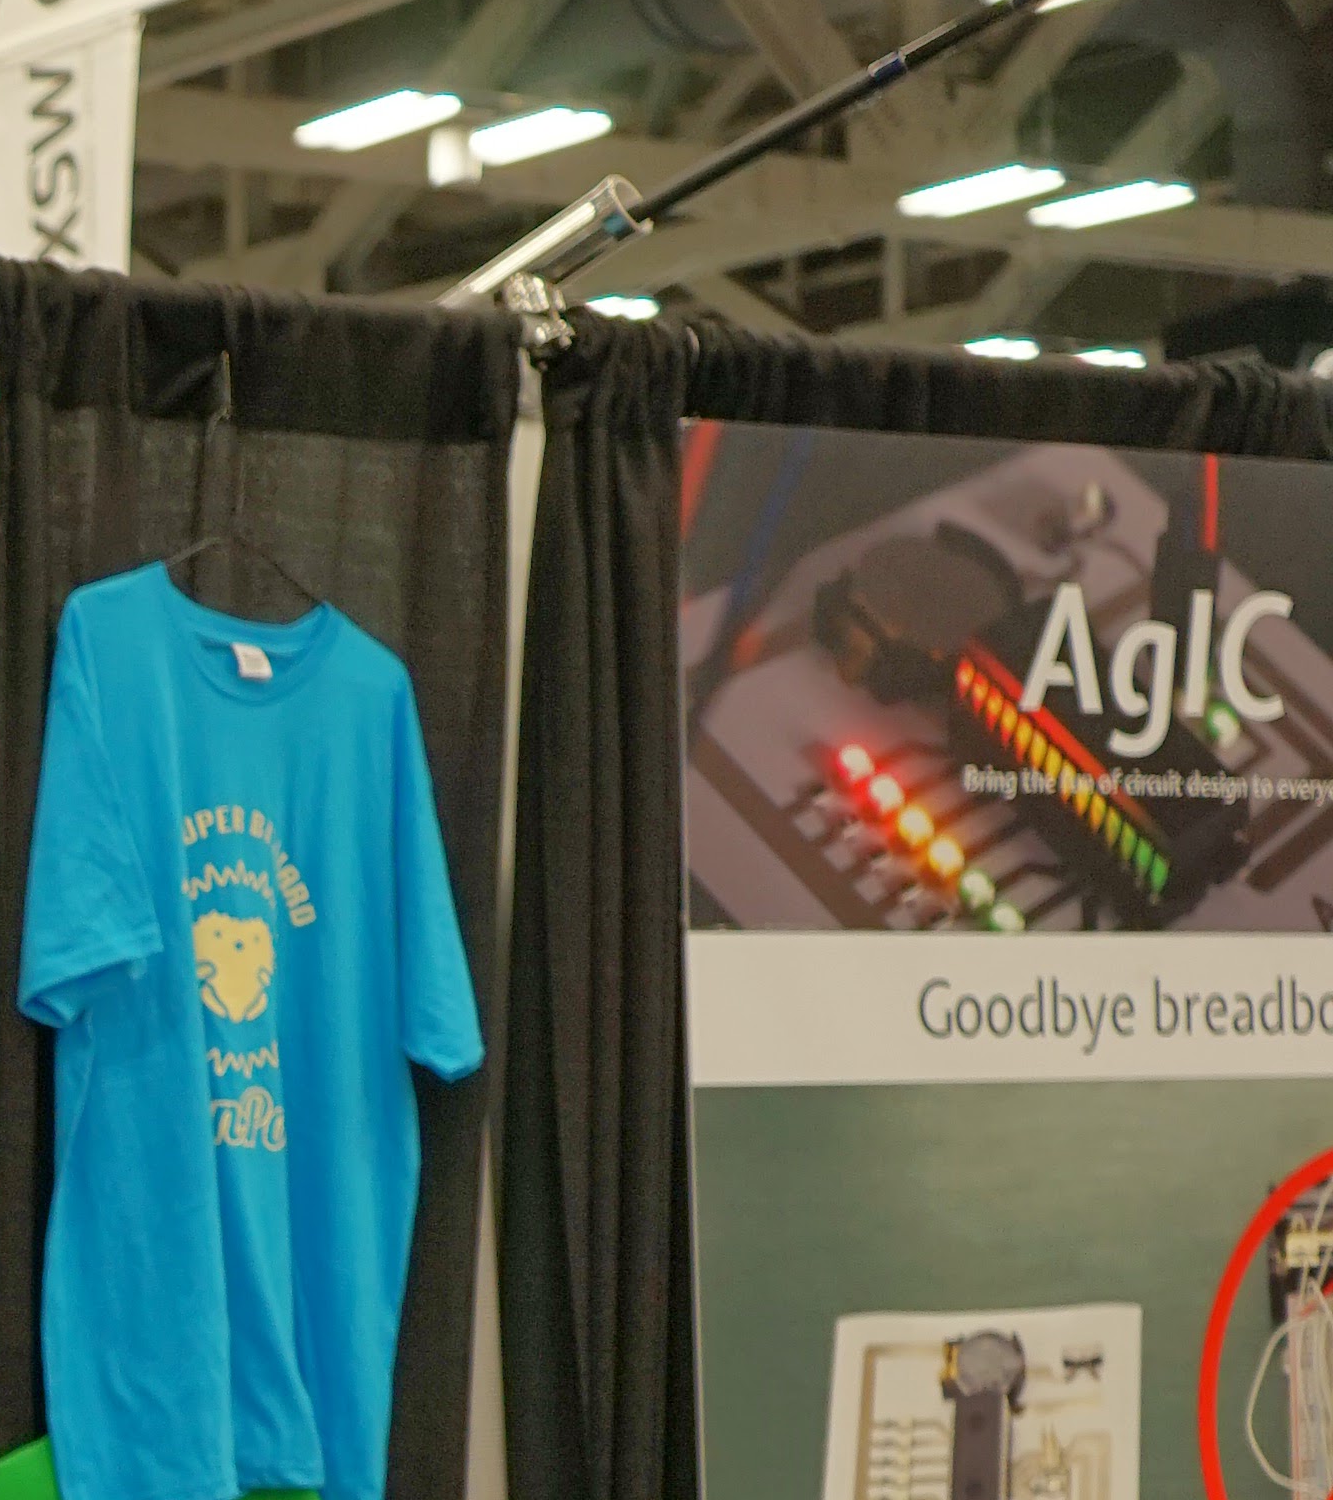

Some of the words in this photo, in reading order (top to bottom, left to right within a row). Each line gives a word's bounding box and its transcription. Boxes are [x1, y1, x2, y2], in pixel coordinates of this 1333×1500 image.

[27, 68, 80, 263] XSW
[1020, 582, 1294, 758] AgIC
[963, 763, 1017, 800] Bring
[1018, 768, 1056, 795] the
[1095, 767, 1122, 796] of
[1123, 769, 1184, 797] circuit
[1186, 769, 1248, 805] design
[1251, 774, 1274, 800] to
[919, 975, 1136, 1056] Goodbye
